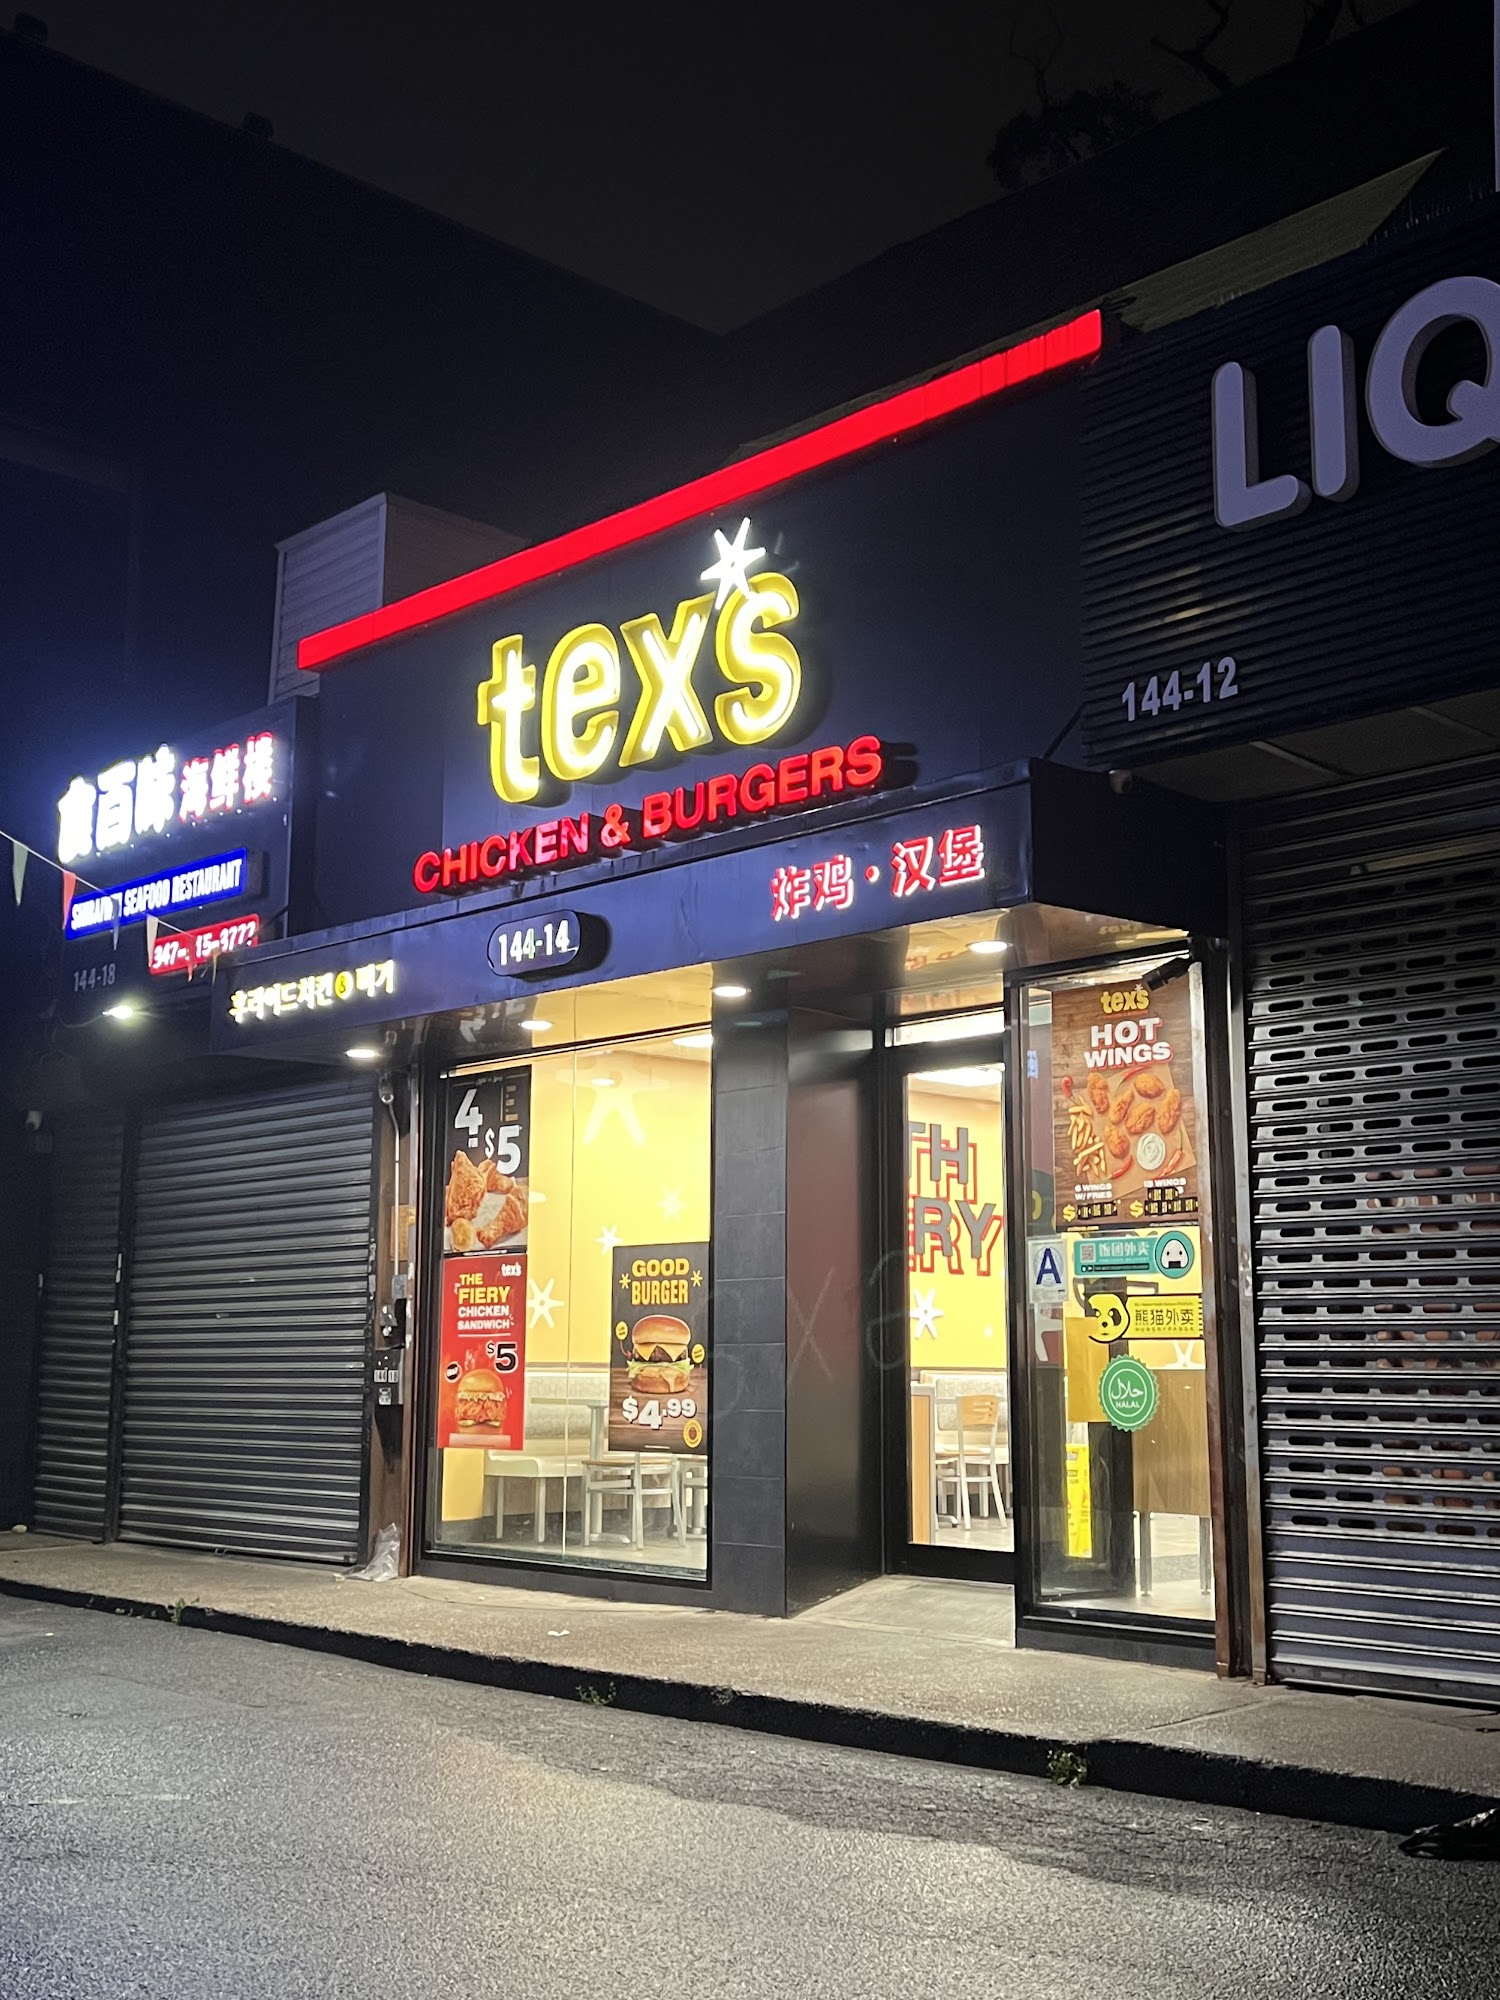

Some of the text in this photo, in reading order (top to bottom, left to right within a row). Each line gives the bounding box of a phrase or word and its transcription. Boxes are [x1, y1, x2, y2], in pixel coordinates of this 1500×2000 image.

[1122, 656, 1239, 722] 144-12
[413, 736, 883, 894] CHICKEN & BURGERS
[123, 879, 171, 916] SEAFOOD
[172, 858, 242, 904] RESTAURANT
[499, 919, 571, 966] 144-14
[73, 963, 116, 992] 144-18
[1091, 1017, 1162, 1048] HOT
[1084, 1041, 1172, 1068] WINGS
[454, 1088, 483, 1135] 4
[485, 1124, 522, 1175] $5
[1083, 1183, 1112, 1192] WINGS
[1087, 1191, 1112, 1199] FRIES
[1155, 1178, 1187, 1187] WINGS
[459, 1273, 483, 1285] THE
[631, 1258, 690, 1278] GOOD
[1036, 1248, 1061, 1285] A
[458, 1286, 510, 1305] FIERY
[631, 1279, 689, 1305] BURGER
[457, 1319, 510, 1330] SANDWICH
[458, 1305, 510, 1318] CHICKEN
[1135, 1309, 1194, 1326] 熊猫外卖
[486, 1340, 518, 1373] $5
[1111, 1378, 1144, 1400] حلال
[622, 1395, 697, 1431] $4.99
[1115, 1400, 1140, 1409] HALAL
